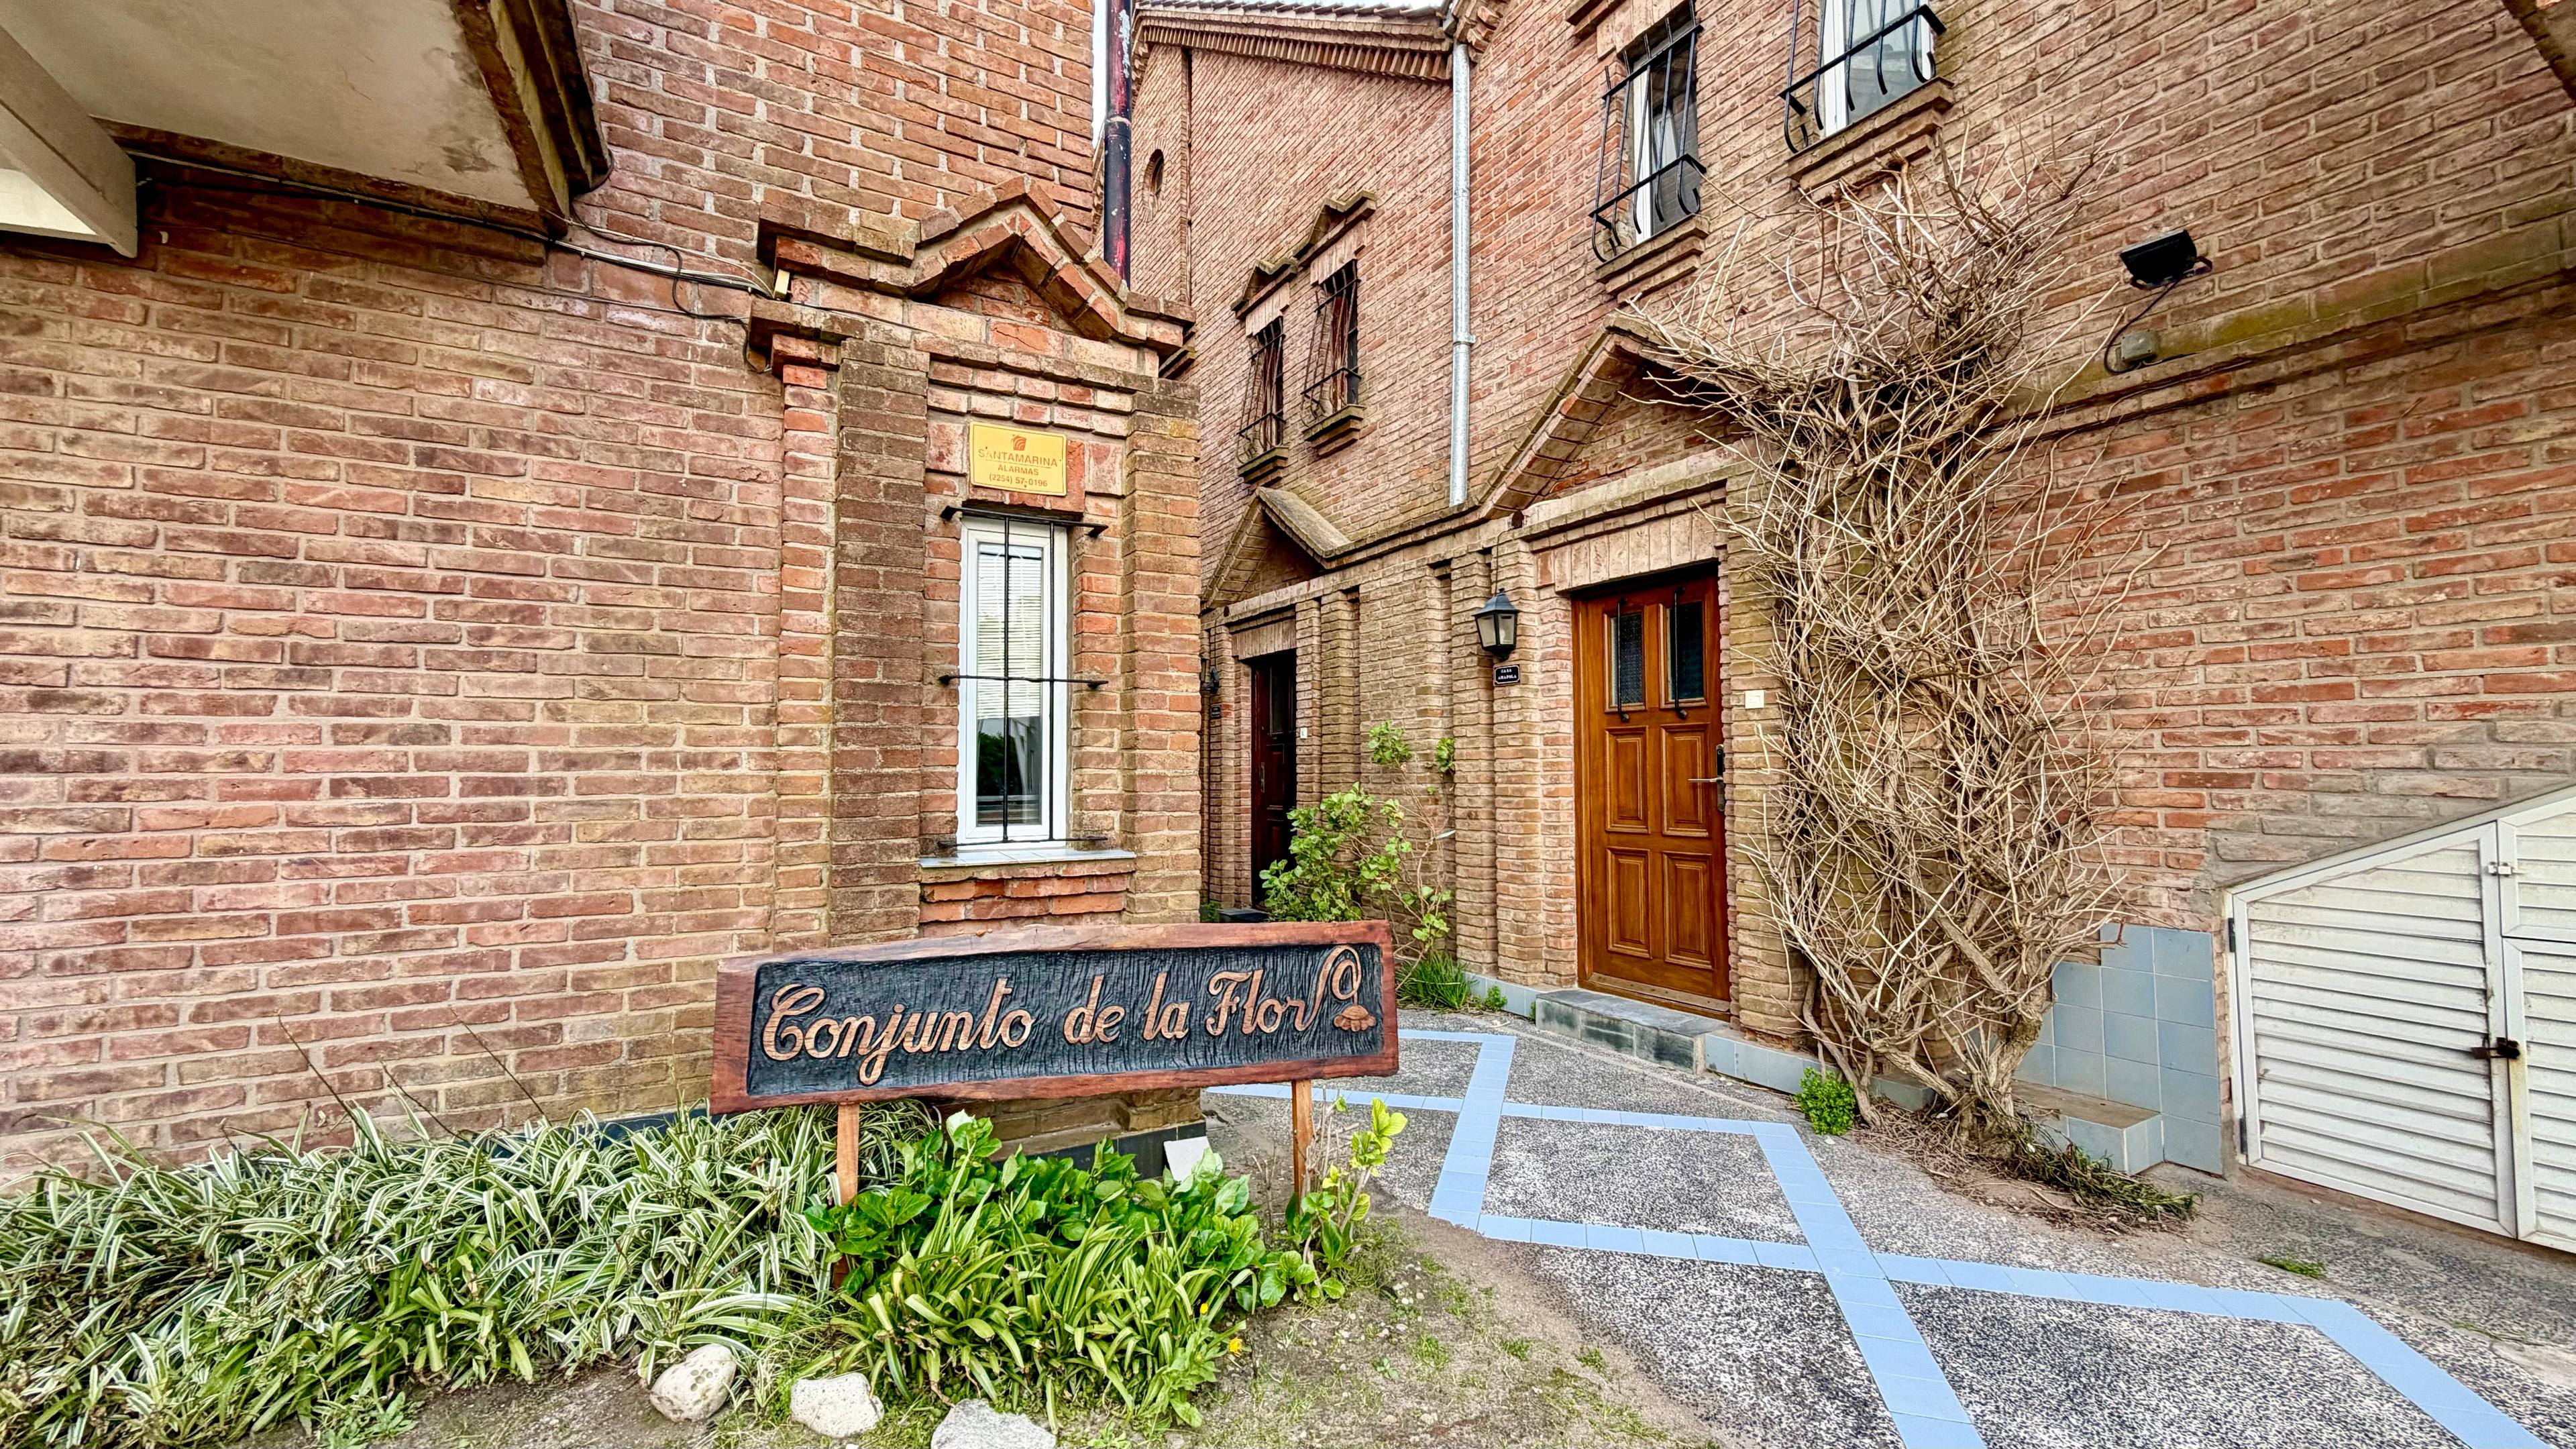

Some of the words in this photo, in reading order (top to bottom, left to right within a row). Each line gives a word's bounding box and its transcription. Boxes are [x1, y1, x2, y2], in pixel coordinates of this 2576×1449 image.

[978, 448, 1058, 467] SANTAMARINA
[998, 464, 1039, 476] ALARMAS
[989, 473, 1013, 484] (2254)
[1016, 476, 1048, 487] 57-0196
[761, 977, 1035, 1087] Conjunto
[1063, 975, 1124, 1045] de
[1142, 972, 1190, 1040] la
[1205, 961, 1327, 1036] Flor
